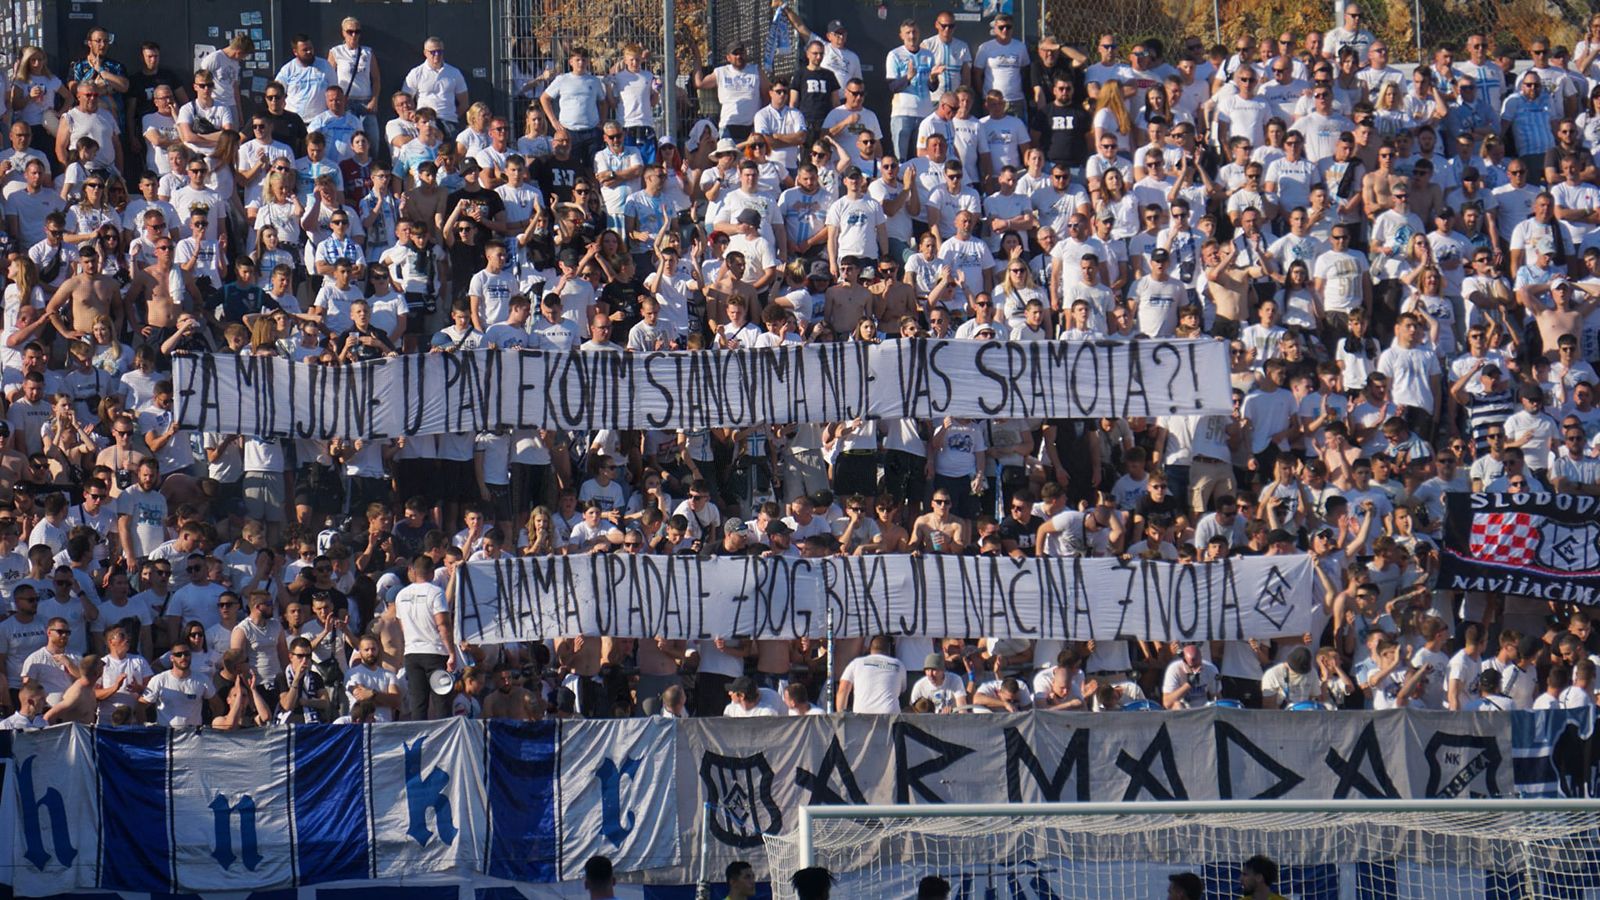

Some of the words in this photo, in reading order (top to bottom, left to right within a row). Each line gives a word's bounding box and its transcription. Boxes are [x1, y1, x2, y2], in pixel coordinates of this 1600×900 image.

[807, 79, 827, 93] RI
[1052, 116, 1074, 130] RI
[177, 353, 220, 432] ZA
[402, 355, 425, 436] U
[443, 350, 634, 434] PAVLEKOVIM
[645, 345, 810, 430] STANOVIMA
[818, 342, 882, 421] NIJE
[897, 337, 952, 418] VAS
[460, 561, 484, 641] A
[495, 555, 583, 640] NAMA
[591, 552, 712, 640] UPADATE
[730, 555, 812, 640] ZBOG
[821, 555, 926, 638] BAKLJI
[958, 555, 1095, 640] NAČINA
[796, 717, 1401, 804] ARMADA
[1444, 752, 1460, 765] NK
